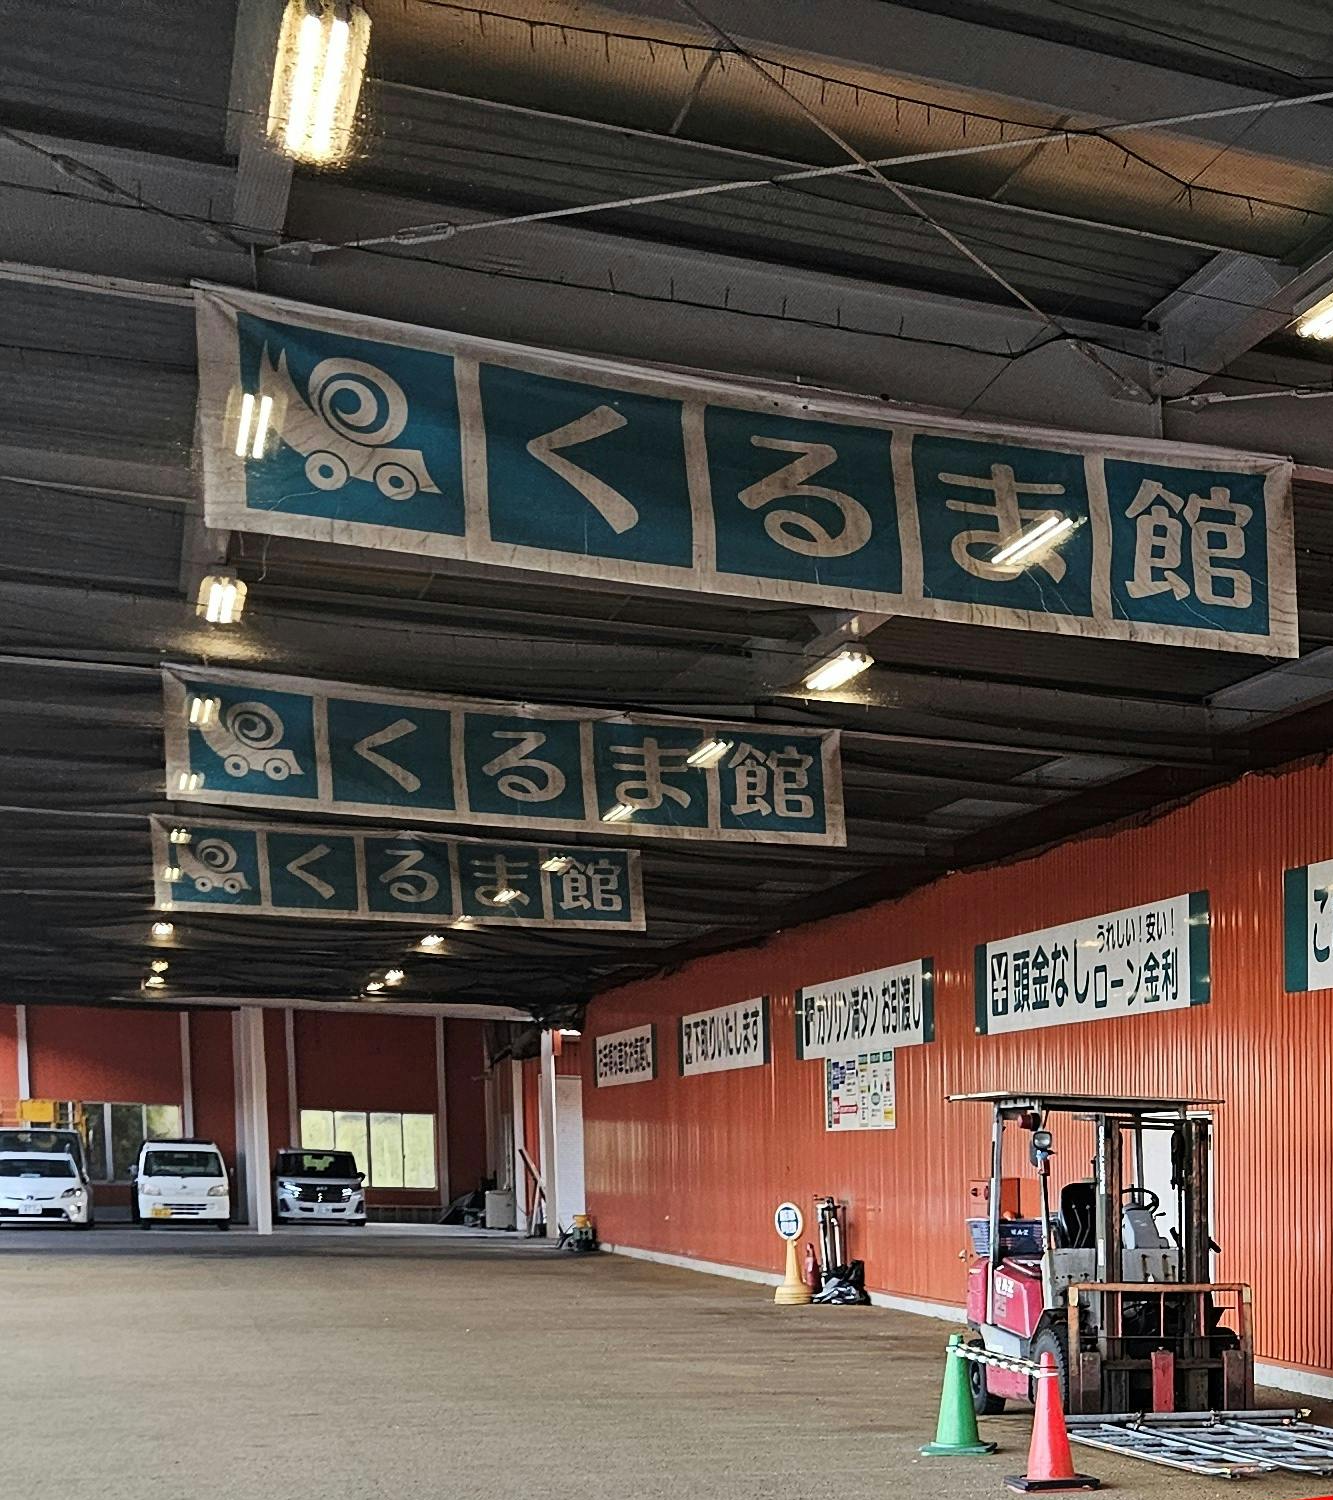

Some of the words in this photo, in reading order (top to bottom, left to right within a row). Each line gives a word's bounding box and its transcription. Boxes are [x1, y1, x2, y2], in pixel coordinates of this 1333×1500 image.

[525, 405, 1254, 609] くるま館
[353, 717, 814, 819] くるま館
[286, 843, 623, 912] くるま館
